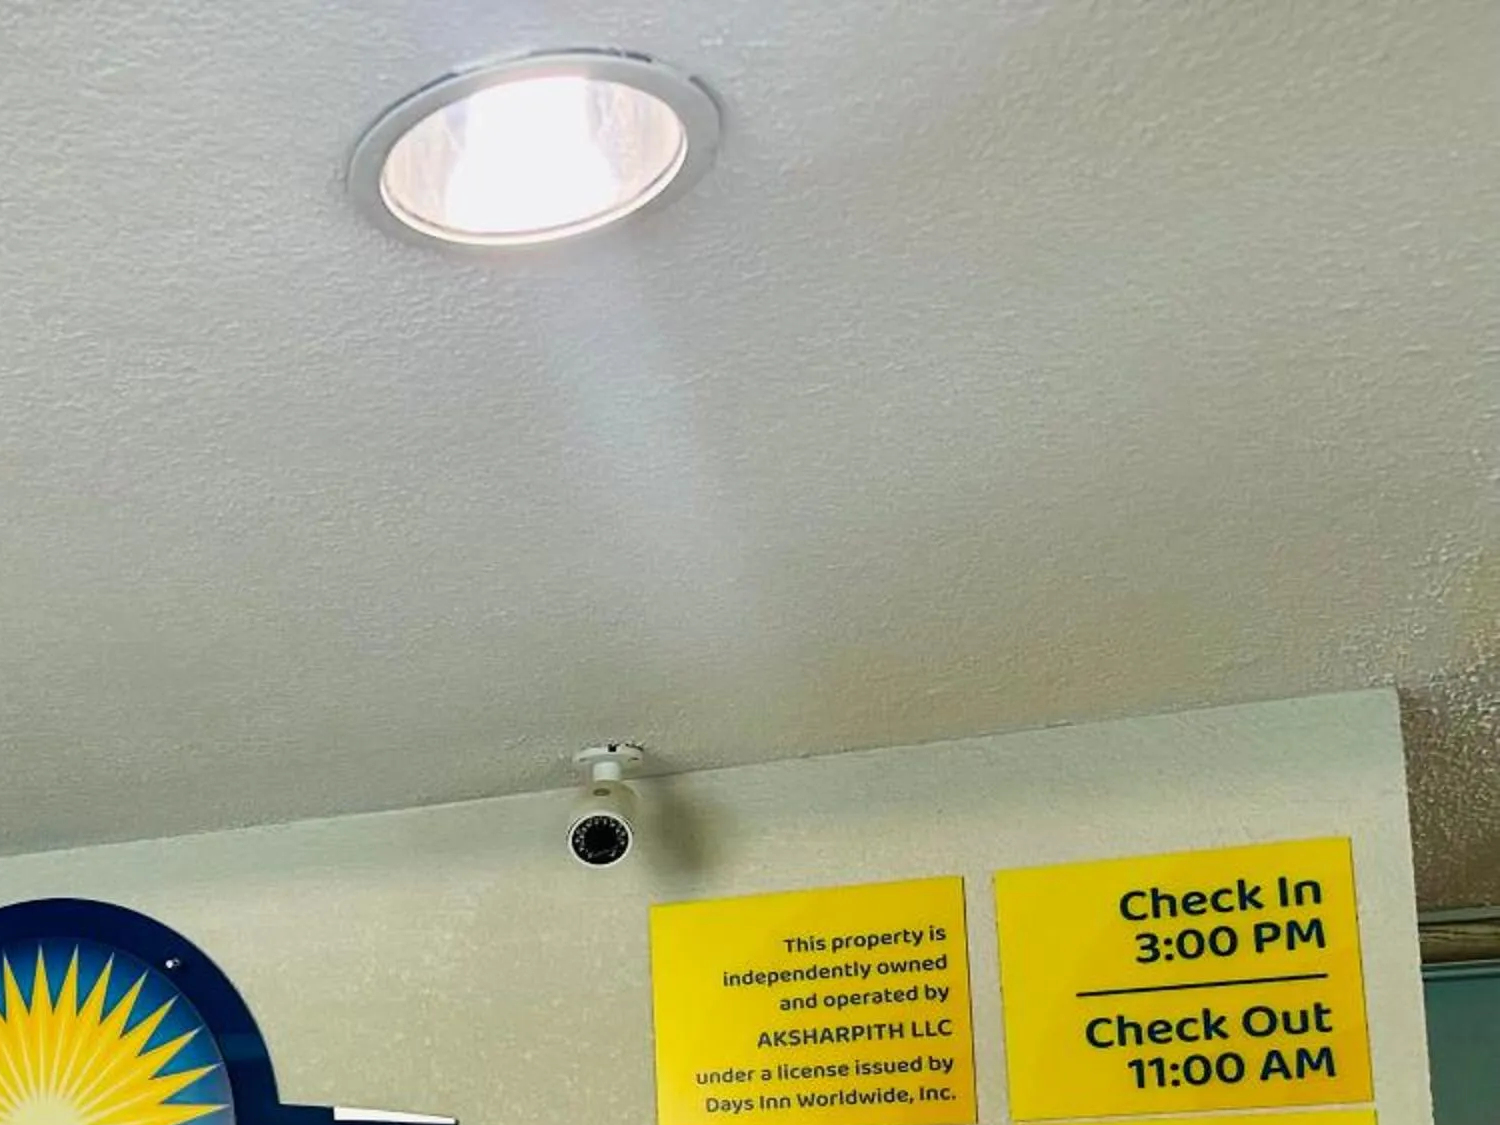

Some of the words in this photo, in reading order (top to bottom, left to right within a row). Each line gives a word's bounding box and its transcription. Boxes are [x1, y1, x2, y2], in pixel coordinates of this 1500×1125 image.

[1119, 879, 1264, 921] Check
[1278, 876, 1322, 907] In
[784, 936, 826, 953] This
[831, 926, 924, 953] property
[929, 925, 946, 941] is
[1135, 926, 1238, 964] 3:00
[1254, 918, 1326, 953] PM
[723, 961, 871, 988] independently
[877, 954, 948, 975] owned
[780, 993, 817, 1011] and
[823, 985, 919, 1010] operated
[924, 983, 949, 1004] by
[757, 1023, 905, 1048] AKSHARPITH
[911, 1019, 953, 1037] LLC
[1085, 1007, 1229, 1048] Check
[1242, 1002, 1333, 1037] Out
[696, 1067, 754, 1085] under
[760, 1068, 772, 1081] a
[777, 1063, 850, 1080] license
[855, 1056, 923, 1075] issued
[928, 1055, 954, 1075] by
[1128, 1052, 1245, 1089] 11:00
[1260, 1047, 1336, 1081] AM
[706, 1096, 754, 1114] Days
[759, 1095, 792, 1110] Inn
[797, 1088, 914, 1108] Worldwide,
[919, 1086, 957, 1101] Inc.
